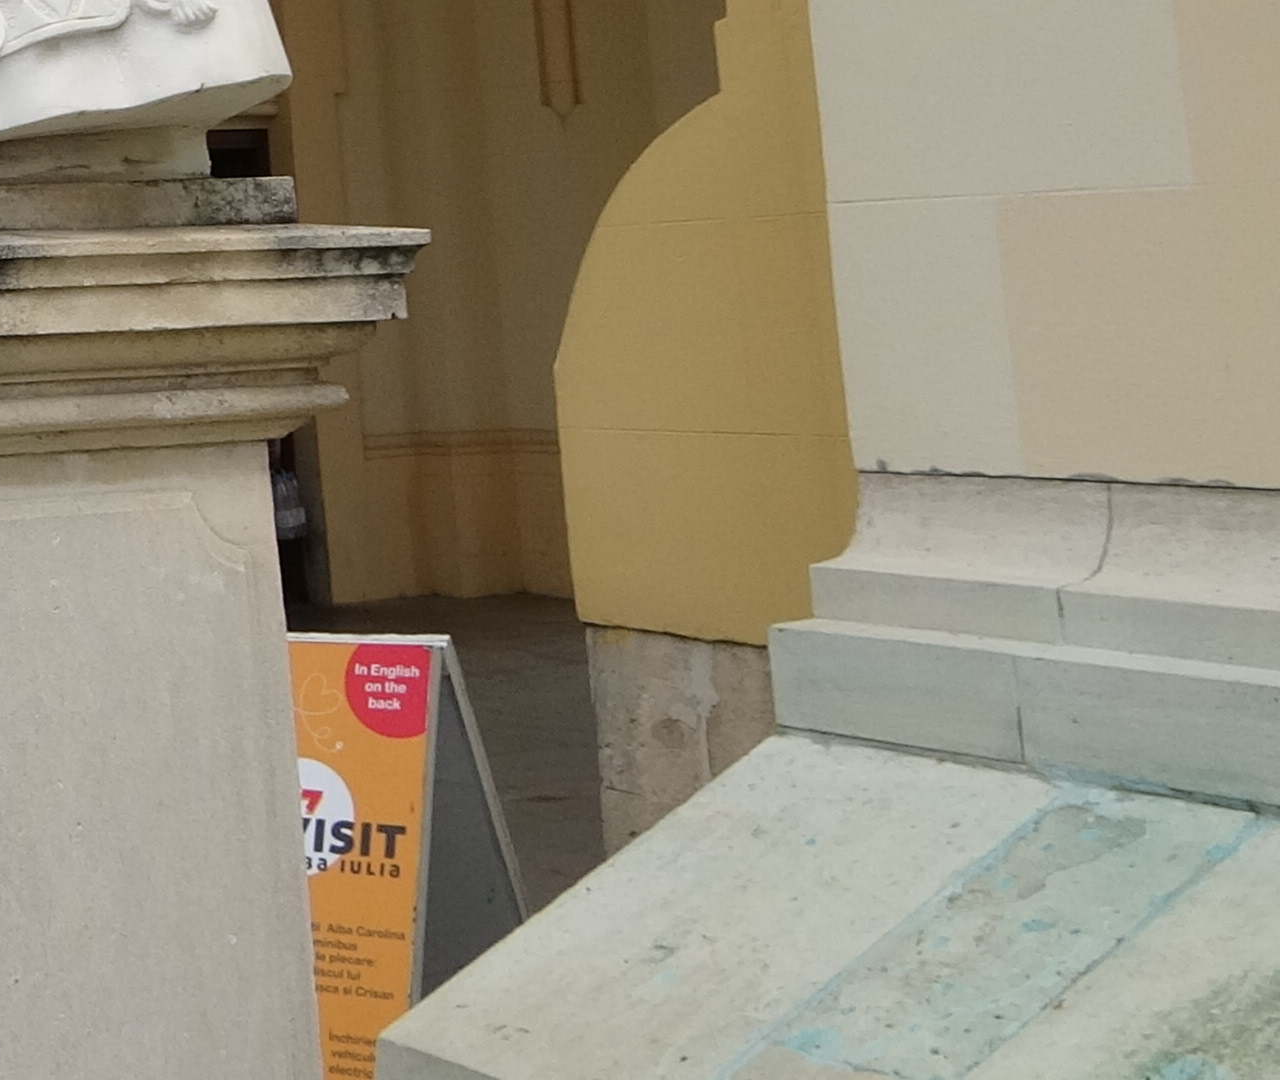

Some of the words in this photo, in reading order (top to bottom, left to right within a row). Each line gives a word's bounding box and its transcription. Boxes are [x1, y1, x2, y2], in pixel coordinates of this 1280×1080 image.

[354, 663, 368, 676] In
[370, 664, 420, 680] English
[364, 682, 382, 693] on
[385, 681, 407, 694] the
[368, 696, 401, 711] back
[327, 923, 353, 935] Alba
[356, 926, 406, 941] Carolina
[346, 969, 361, 981] lui
[355, 986, 395, 1000] Crisan
